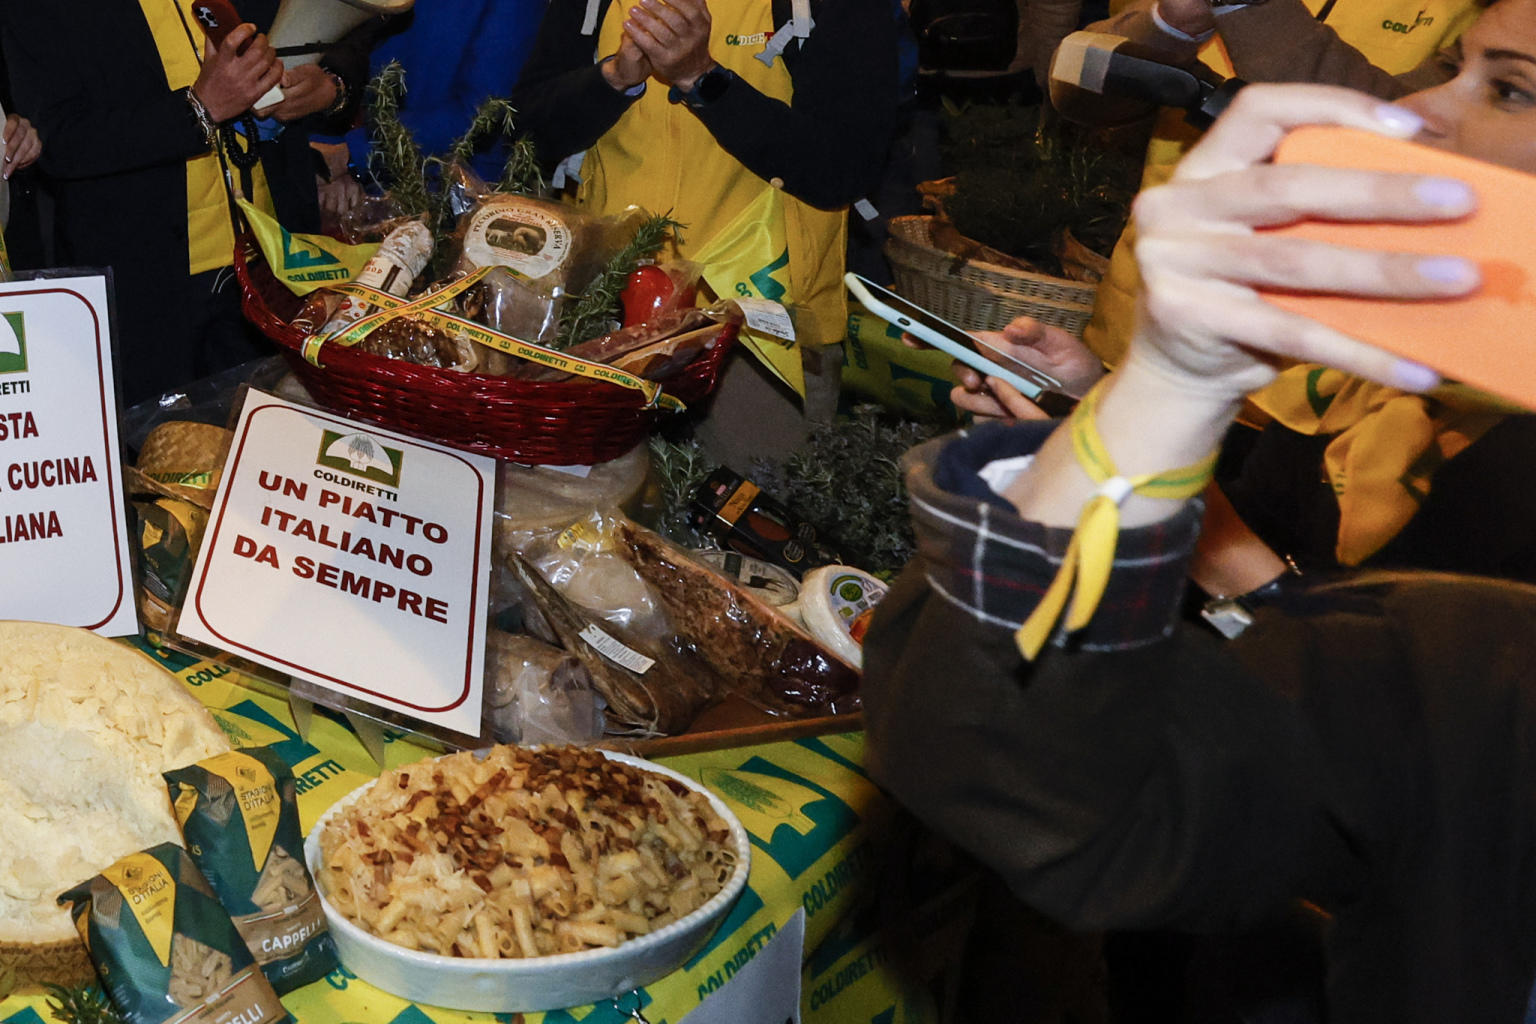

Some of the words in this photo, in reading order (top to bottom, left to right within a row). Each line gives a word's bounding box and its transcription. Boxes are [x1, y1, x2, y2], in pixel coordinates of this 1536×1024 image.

[7, 456, 98, 491] CUCINA
[257, 470, 308, 501] UN
[318, 488, 449, 545] PIATTO
[313, 469, 398, 502] COLDIRETTI
[260, 506, 433, 577] ITALIANO
[232, 534, 280, 569] DA
[292, 555, 449, 624] SEMPRE
